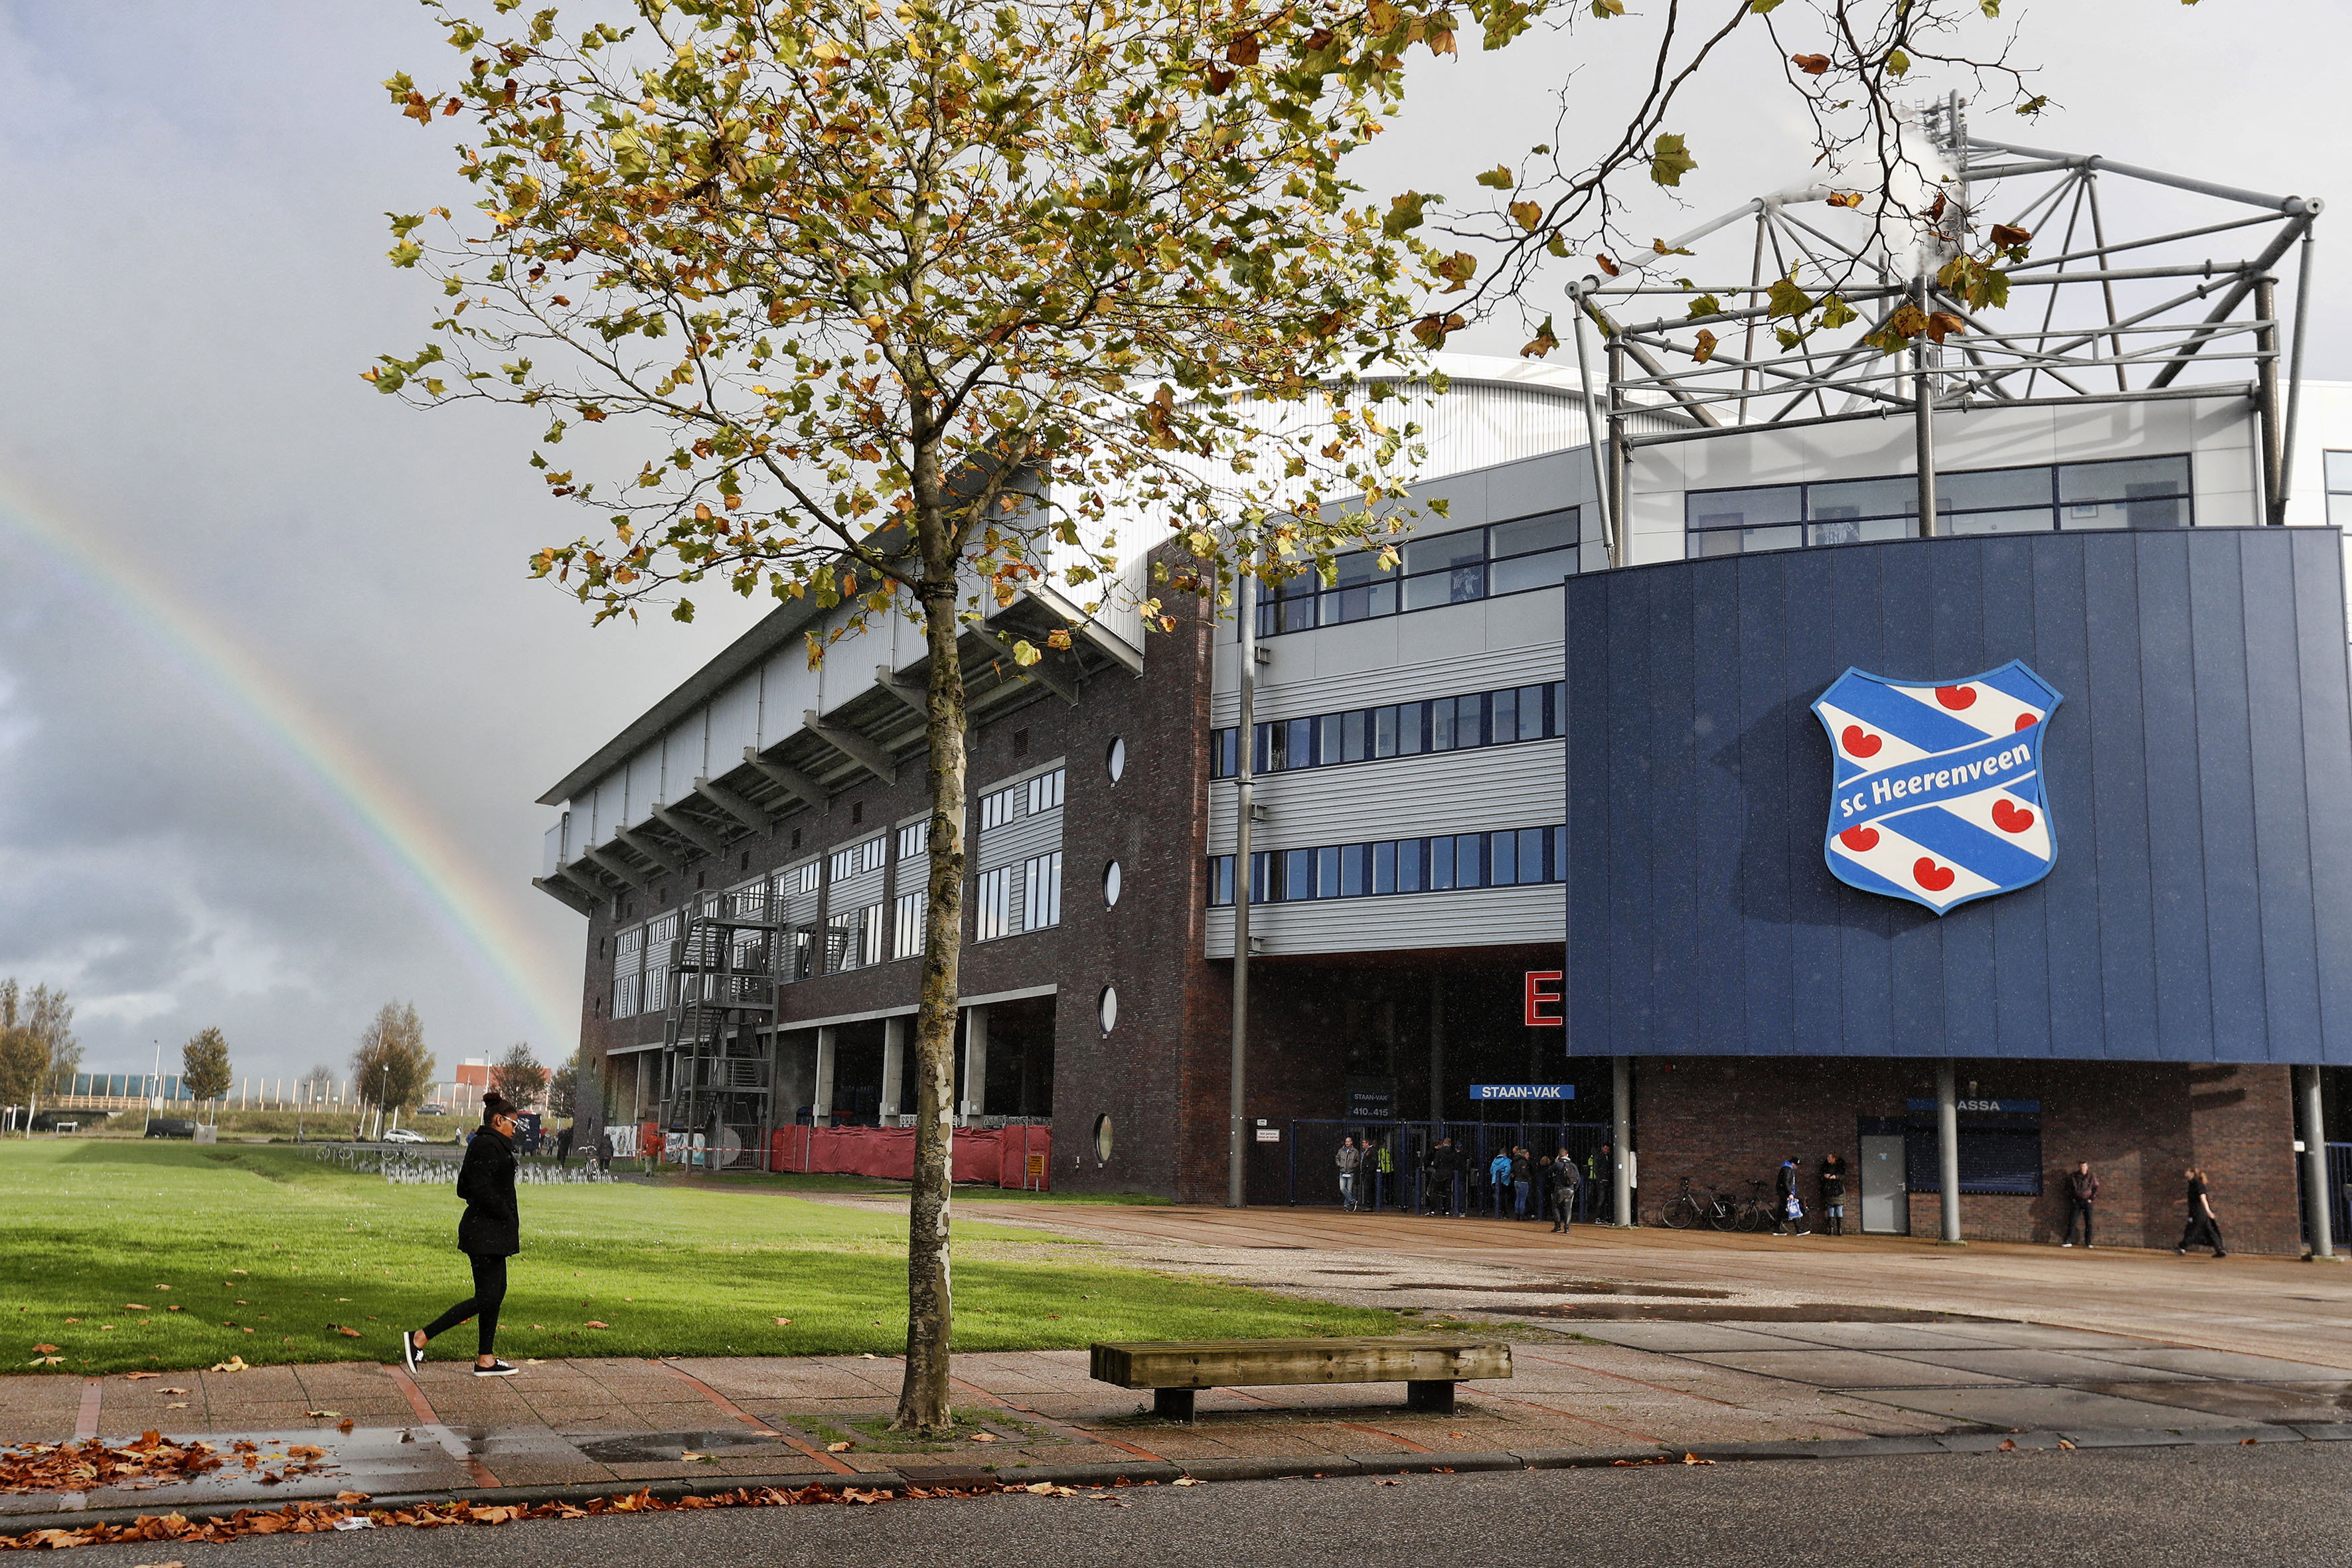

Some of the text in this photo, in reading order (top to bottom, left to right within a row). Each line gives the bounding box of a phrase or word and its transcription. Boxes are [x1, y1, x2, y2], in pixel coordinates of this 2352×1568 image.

[1840, 742, 2031, 818] sc Heerenveen
[1525, 970, 1564, 1027] E
[1482, 1086, 1561, 1098] STAAN-VAK
[1957, 1100, 2001, 1111] ASSA
[1353, 1107, 1368, 1116] 410
[1373, 1108, 1389, 1117] 415
